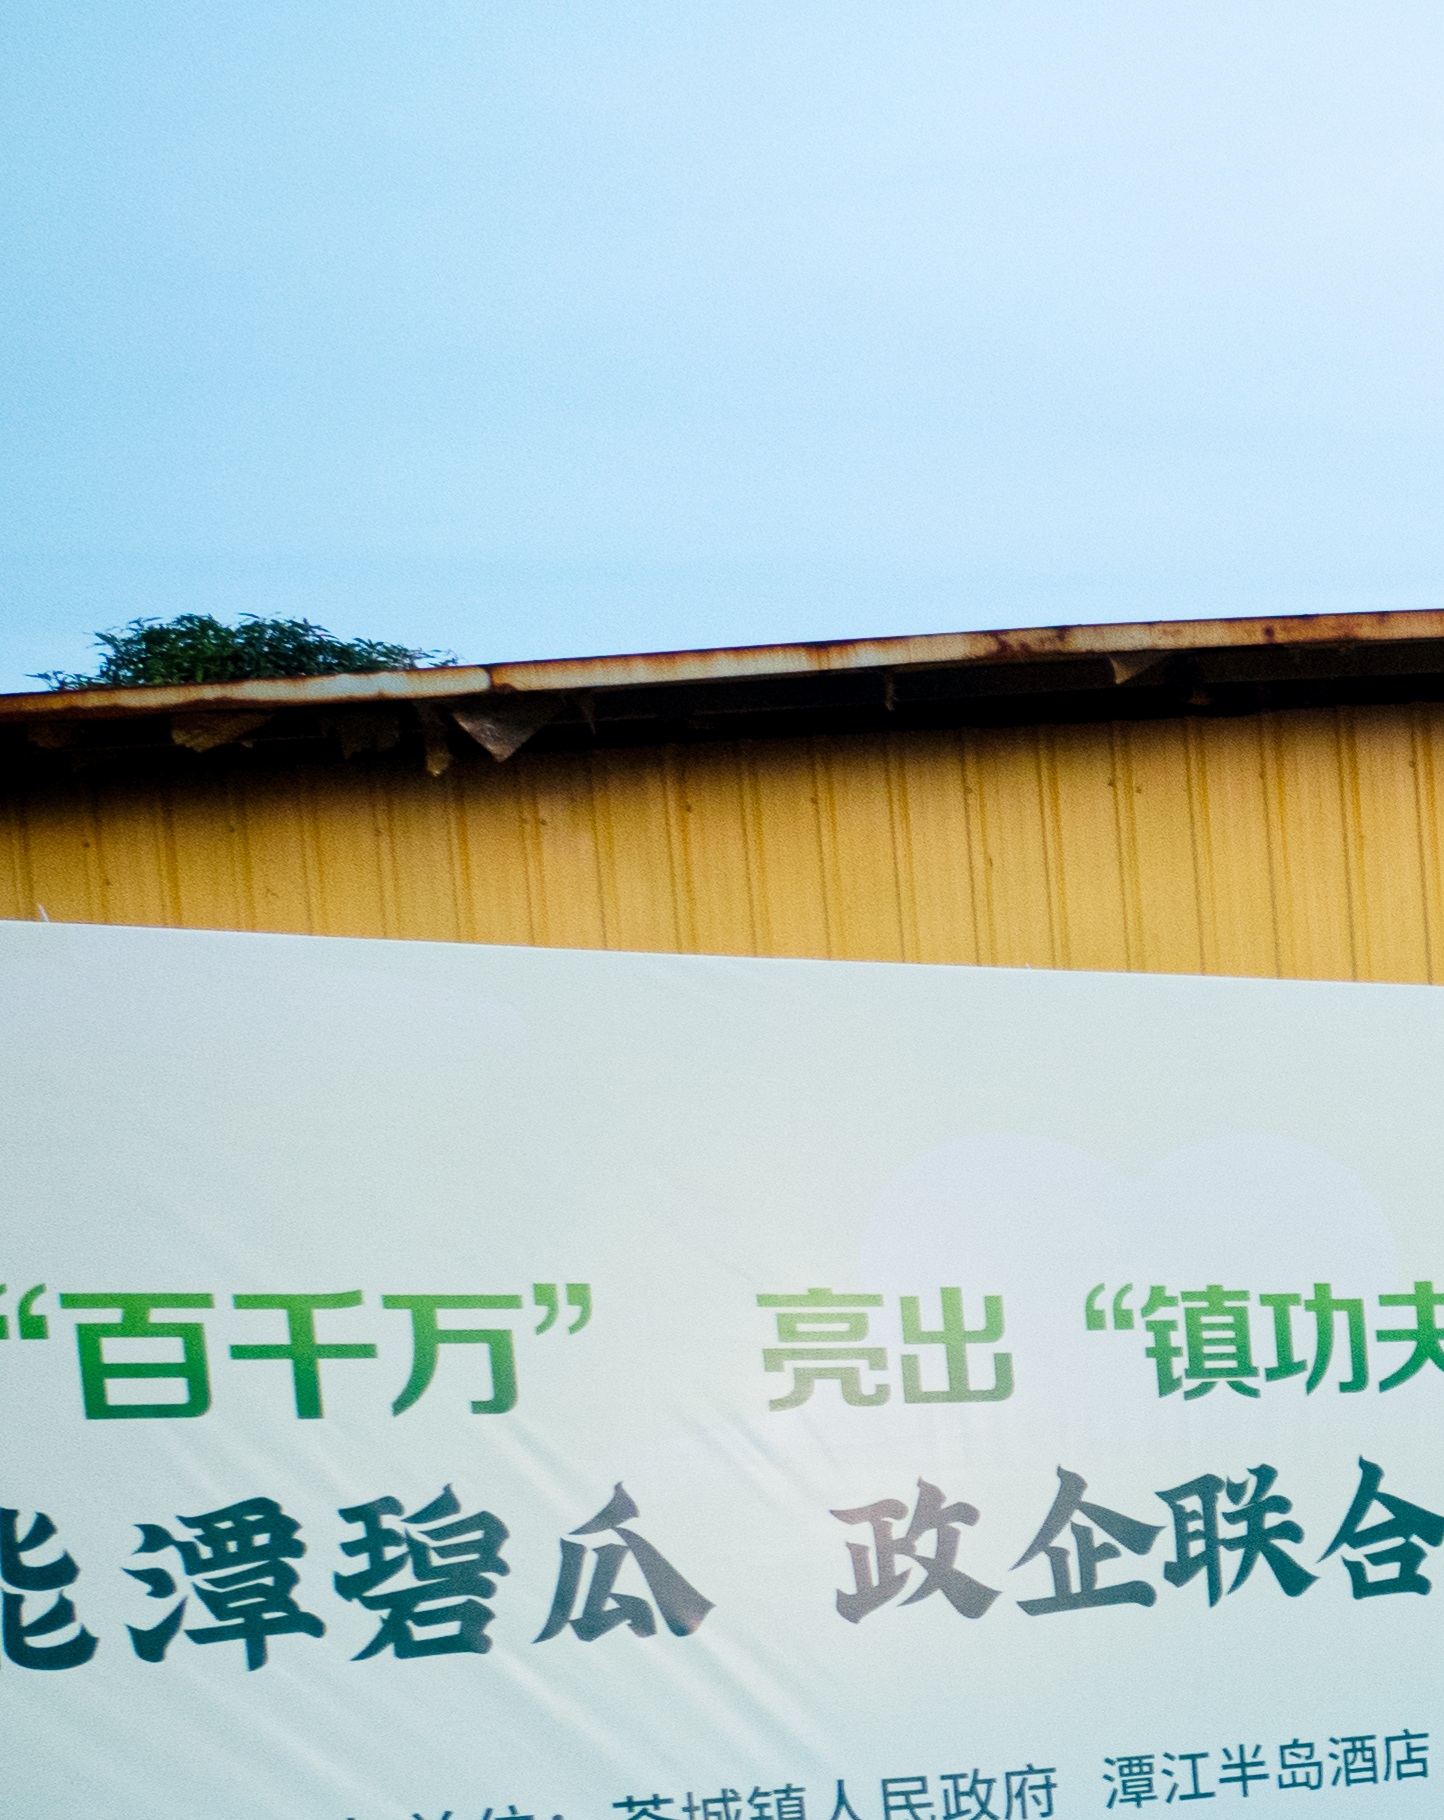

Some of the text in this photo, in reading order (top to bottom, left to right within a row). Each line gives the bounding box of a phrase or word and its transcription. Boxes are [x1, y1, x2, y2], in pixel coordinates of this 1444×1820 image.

[1102, 1728, 1431, 1811] 潭江半岛酒店
